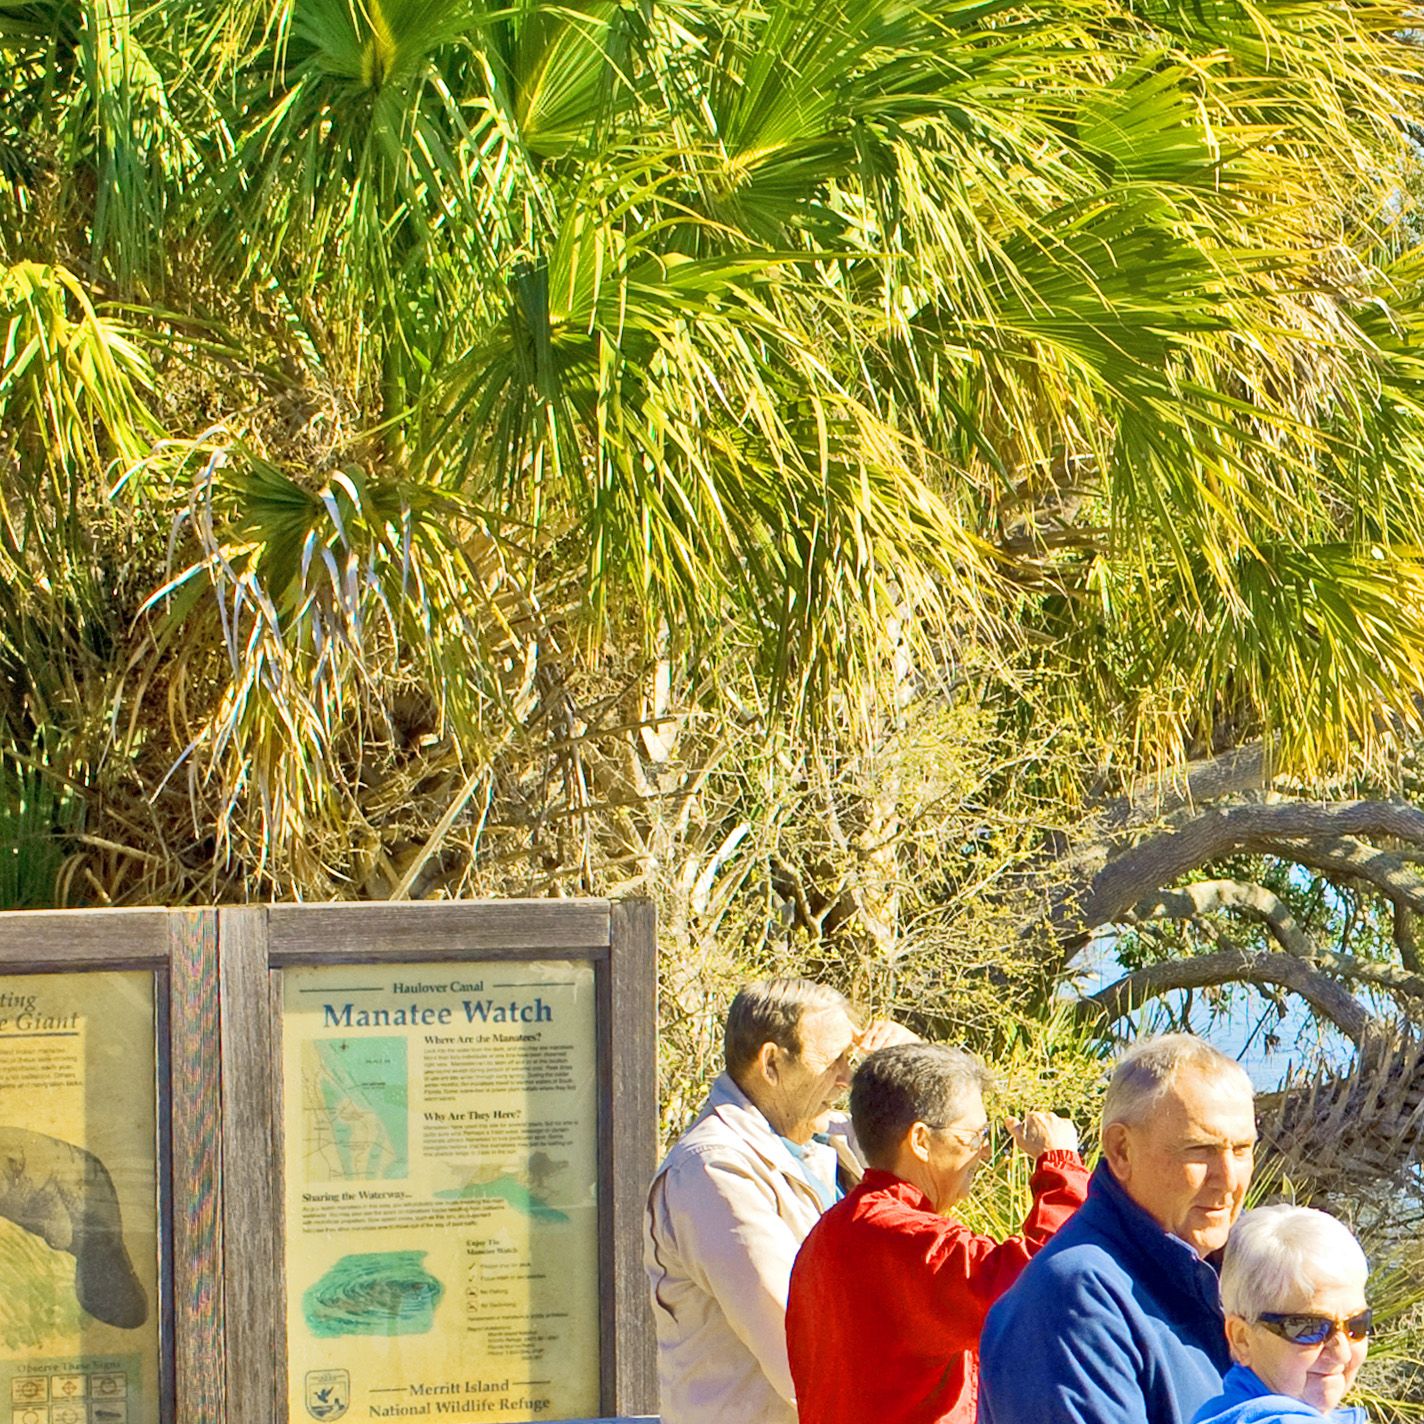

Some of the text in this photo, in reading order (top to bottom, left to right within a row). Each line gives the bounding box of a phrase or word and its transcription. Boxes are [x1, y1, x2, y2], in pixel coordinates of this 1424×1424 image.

[393, 981, 484, 994] Haulover Canal
[323, 998, 553, 1028] Manatee Watch
[16, 1012, 79, 1031] Giant
[424, 1032, 542, 1045] Where Are the Manatees?
[424, 1110, 522, 1123] Why Are They Here?
[302, 1192, 340, 1204] Sharing
[341, 1191, 355, 1201] the
[409, 1379, 509, 1396] Merritt Island
[369, 1396, 551, 1417] National Wildlife Refuge
